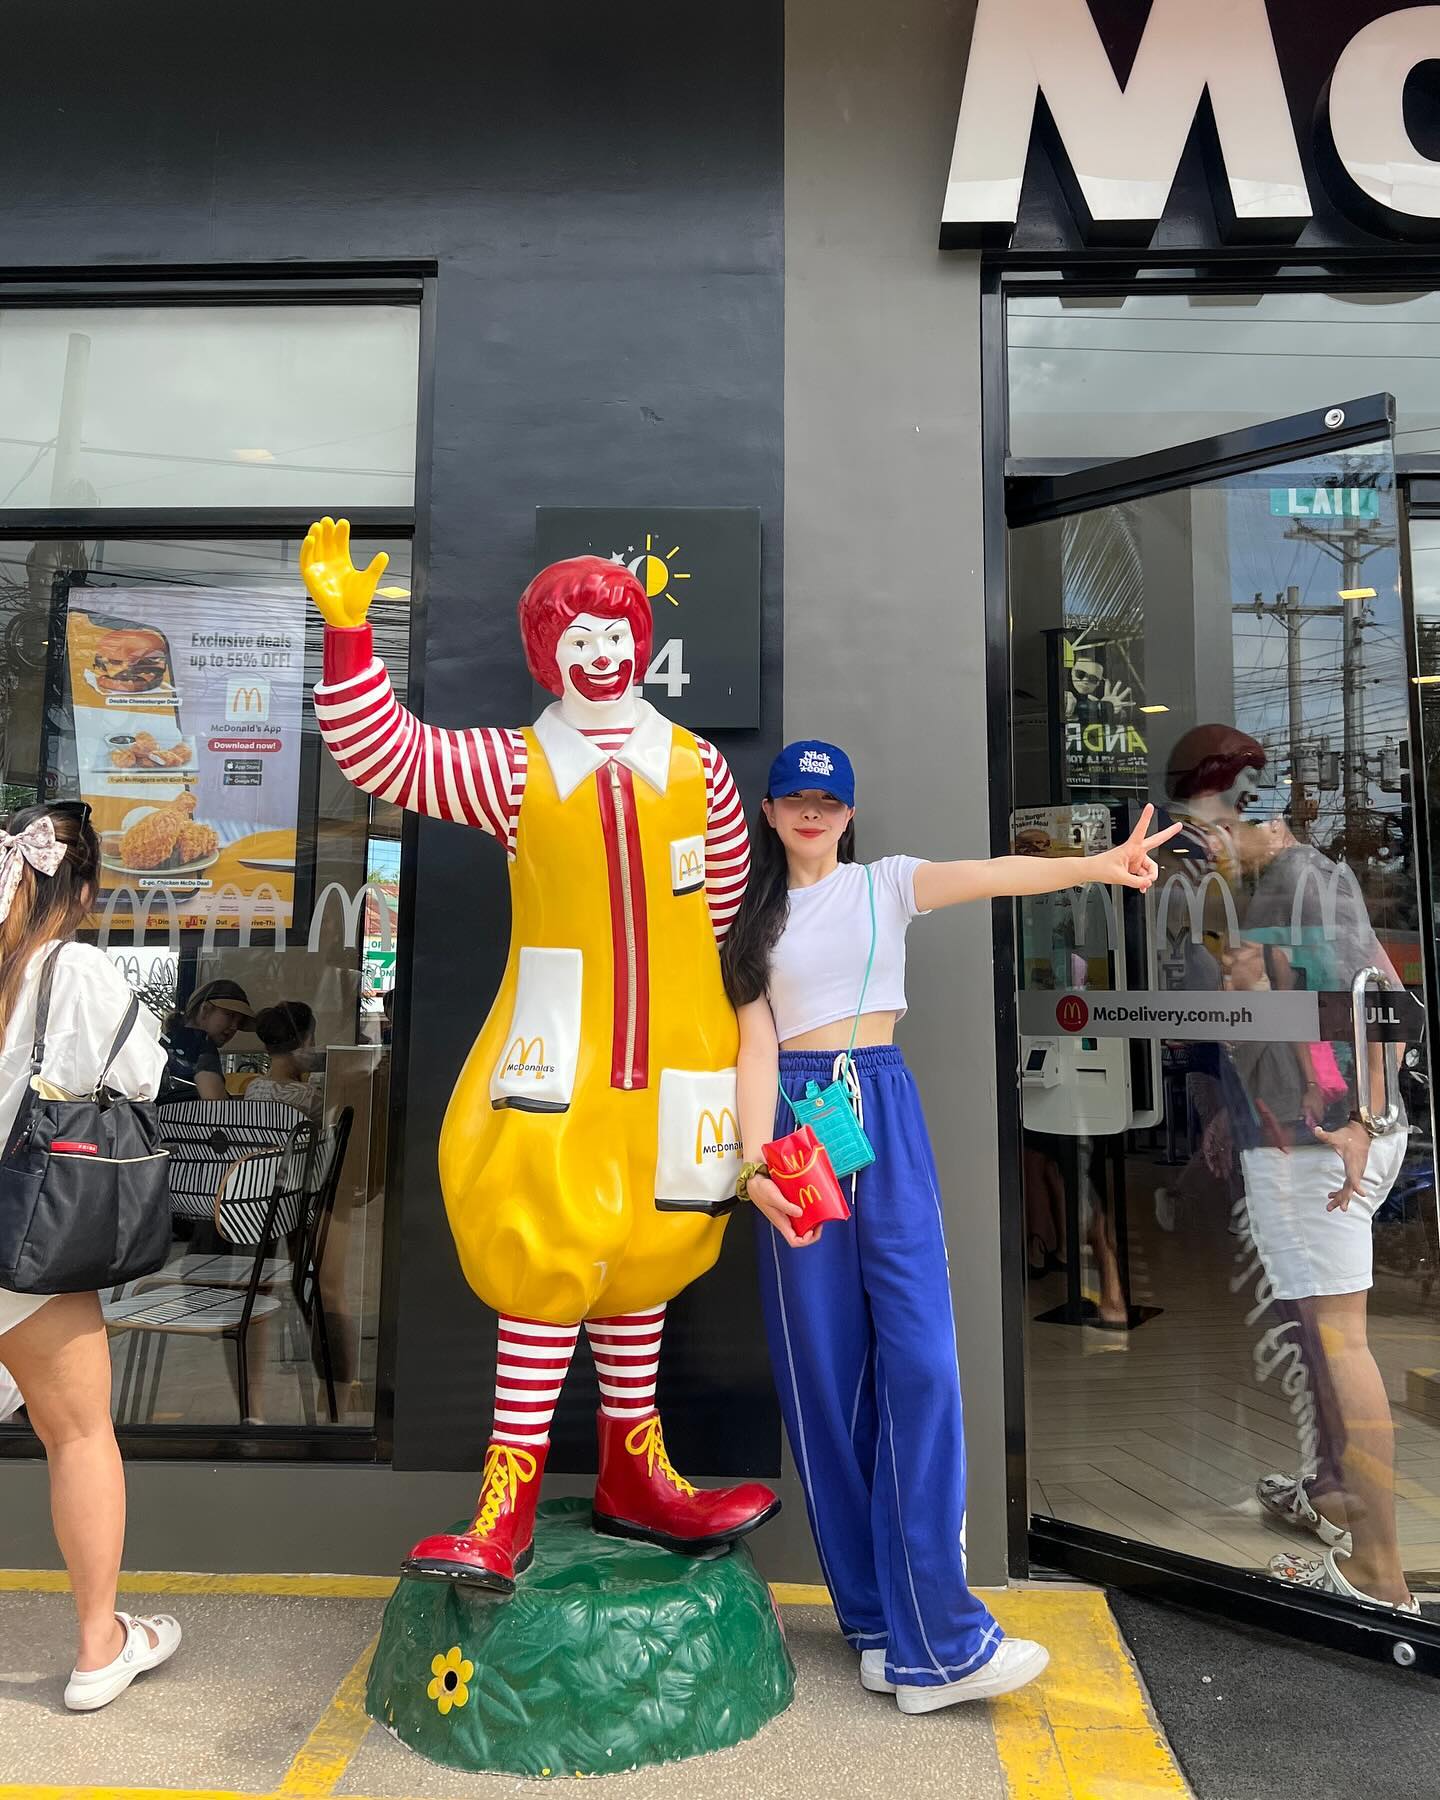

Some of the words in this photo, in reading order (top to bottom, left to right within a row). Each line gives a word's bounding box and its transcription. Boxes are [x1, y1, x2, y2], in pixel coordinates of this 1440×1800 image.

[191, 632, 254, 648] Exclusive
[256, 633, 292, 648] deals
[190, 655, 206, 671] up
[210, 653, 223, 667] to
[227, 652, 257, 667] 55%
[261, 652, 291, 668] OFF!
[633, 638, 691, 699] 4
[210, 724, 262, 733] McDonald's
[264, 725, 282, 735] App
[214, 742, 255, 750] Download
[803, 751, 832, 763] Nick
[799, 759, 834, 771] Nicole
[1093, 1006, 1253, 1026] McDelivery.com.ph
[1350, 1007, 1401, 1024] ULL
[507, 1063, 555, 1073] McDonald's
